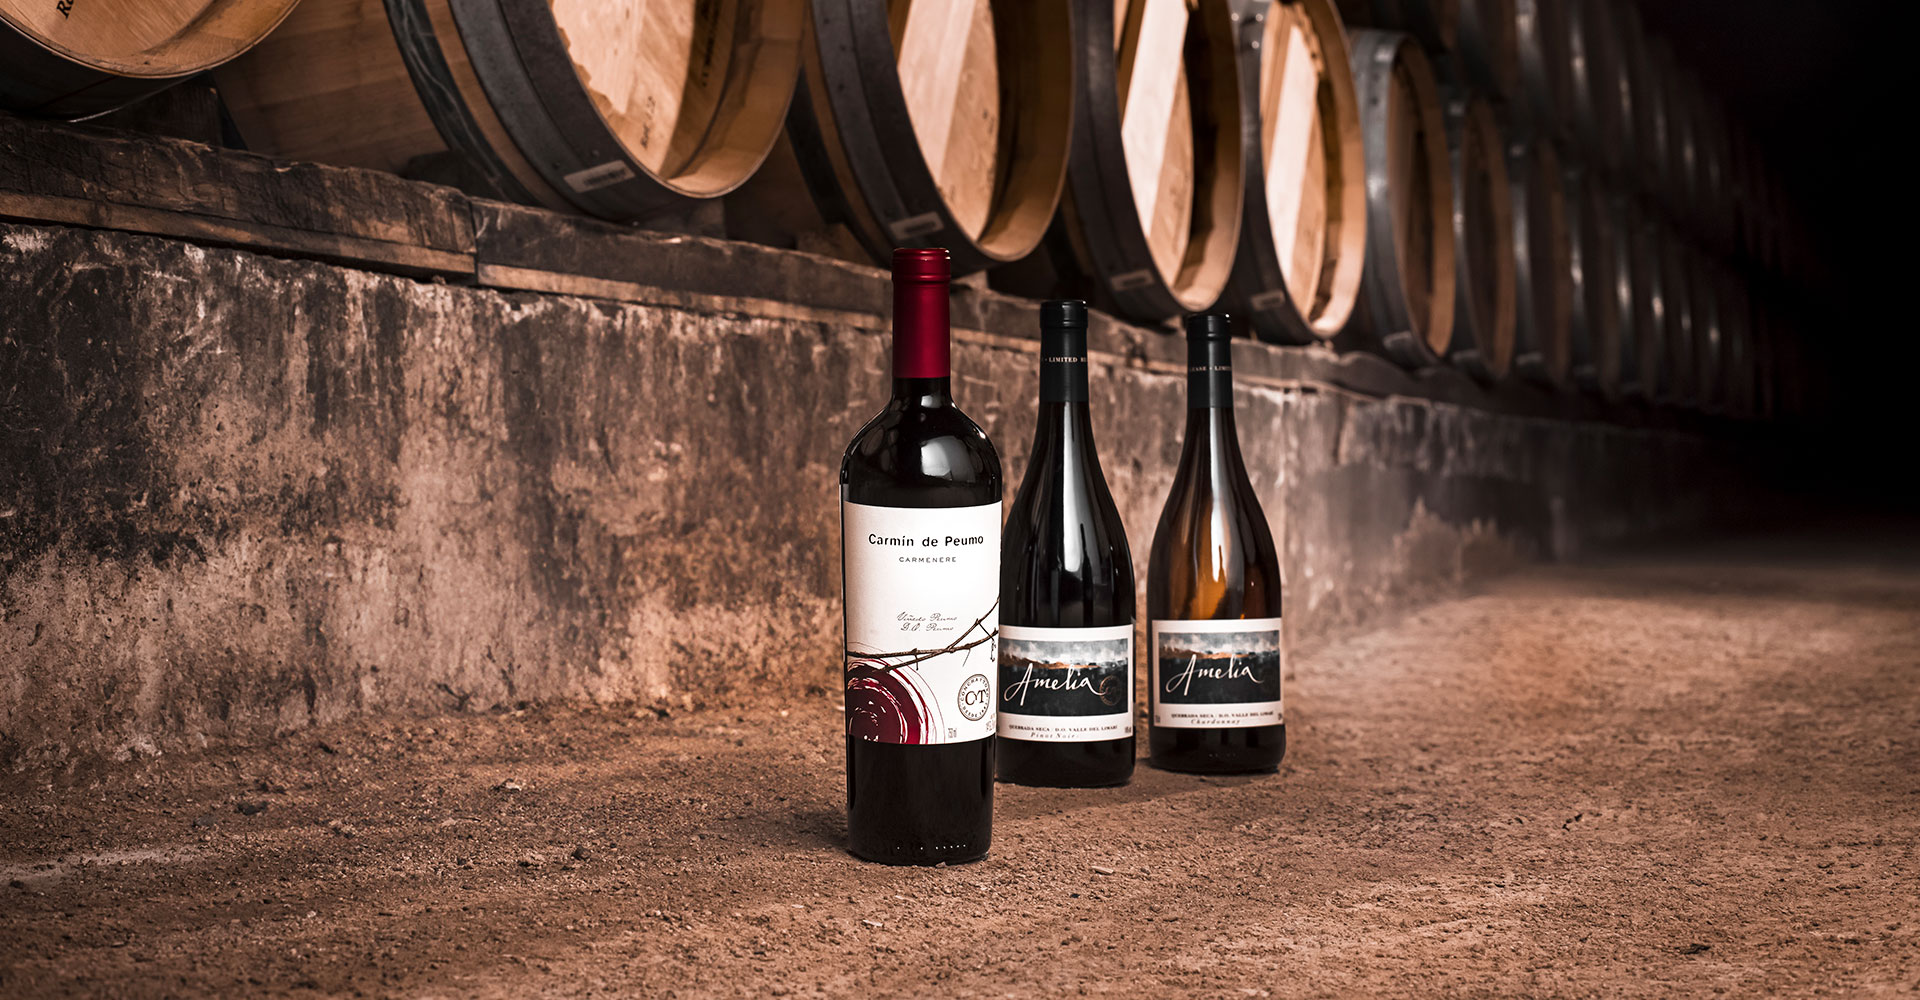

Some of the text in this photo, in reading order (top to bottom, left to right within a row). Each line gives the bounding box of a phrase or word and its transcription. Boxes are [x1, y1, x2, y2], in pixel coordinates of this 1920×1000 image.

[868, 533, 984, 547] Carmín de Peumo
[898, 556, 957, 564] CARMENERE
[1003, 662, 1108, 706] Amelia
[1165, 653, 1264, 696] Amelia
